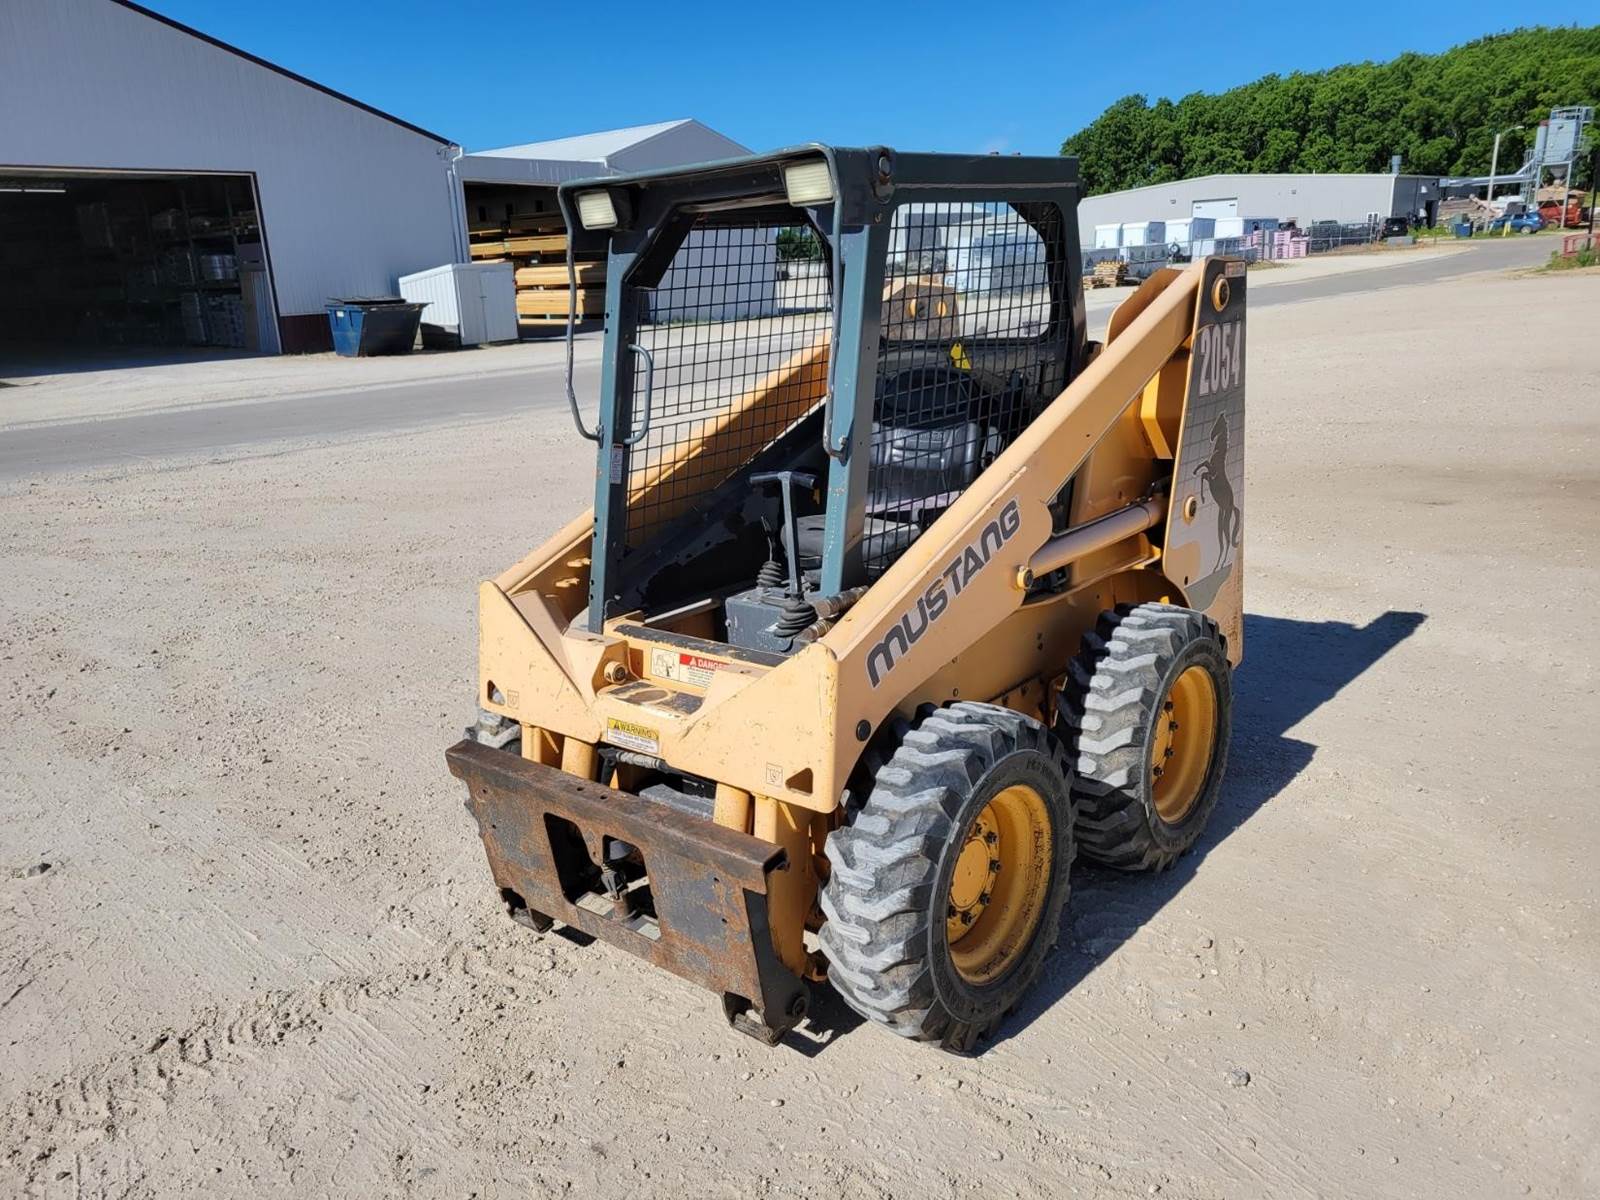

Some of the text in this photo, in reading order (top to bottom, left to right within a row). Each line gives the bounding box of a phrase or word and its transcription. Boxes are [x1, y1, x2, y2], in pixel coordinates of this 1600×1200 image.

[1199, 321, 1241, 396] 2054
[866, 498, 1020, 689] MUSTANG
[619, 720, 652, 738] WARNING
